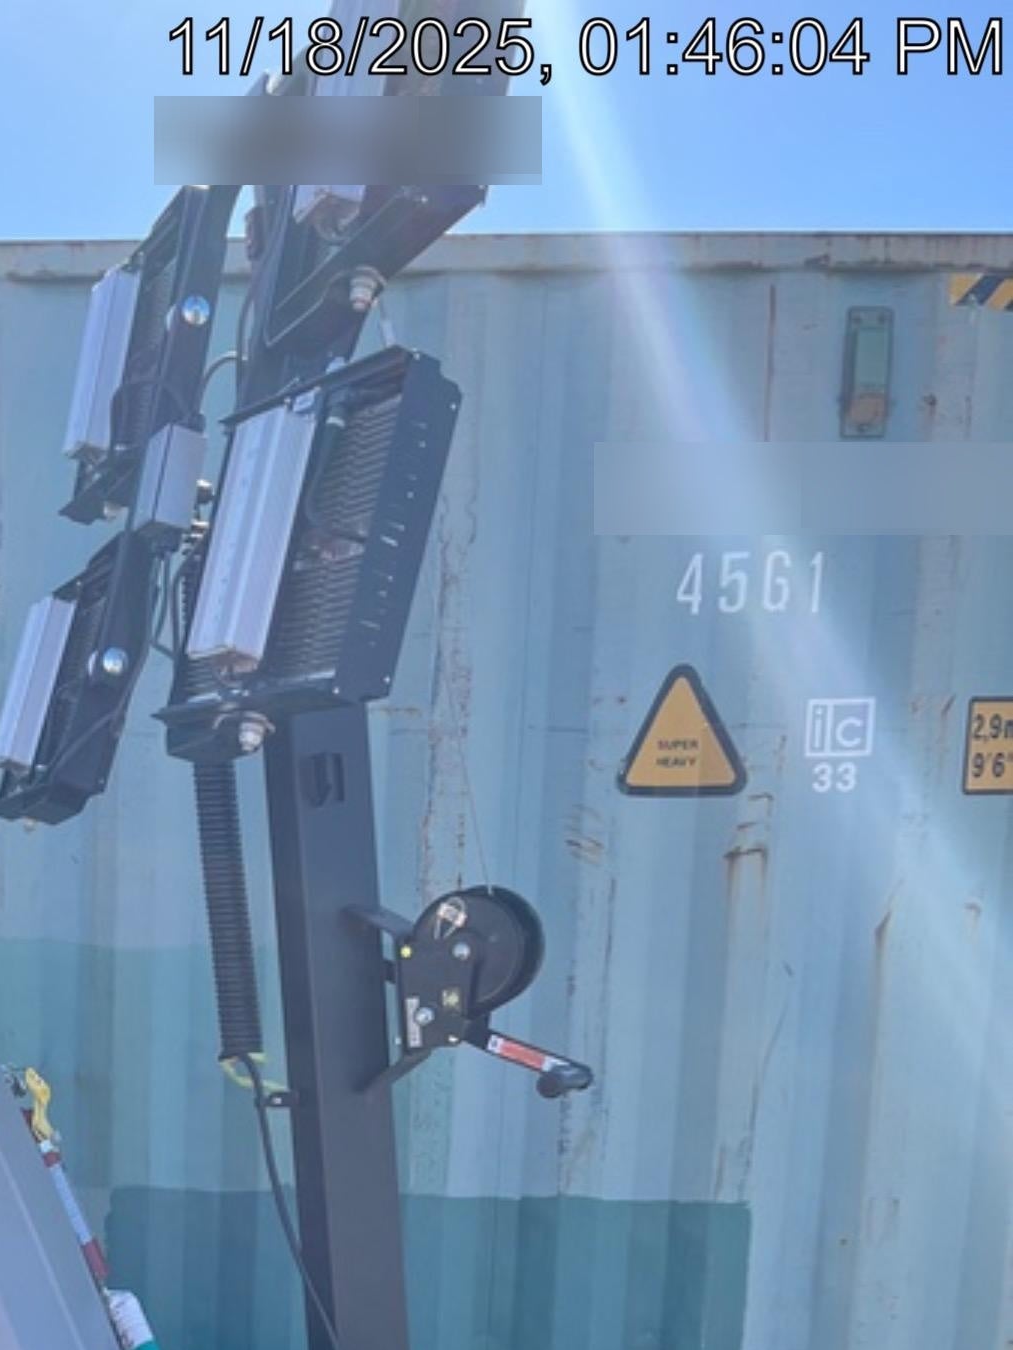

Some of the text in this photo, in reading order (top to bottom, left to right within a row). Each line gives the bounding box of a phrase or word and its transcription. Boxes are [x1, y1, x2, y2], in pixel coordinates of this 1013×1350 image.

[656, 739, 699, 751] SUPER
[655, 756, 698, 769] HEAVY
[811, 763, 858, 793] 33
